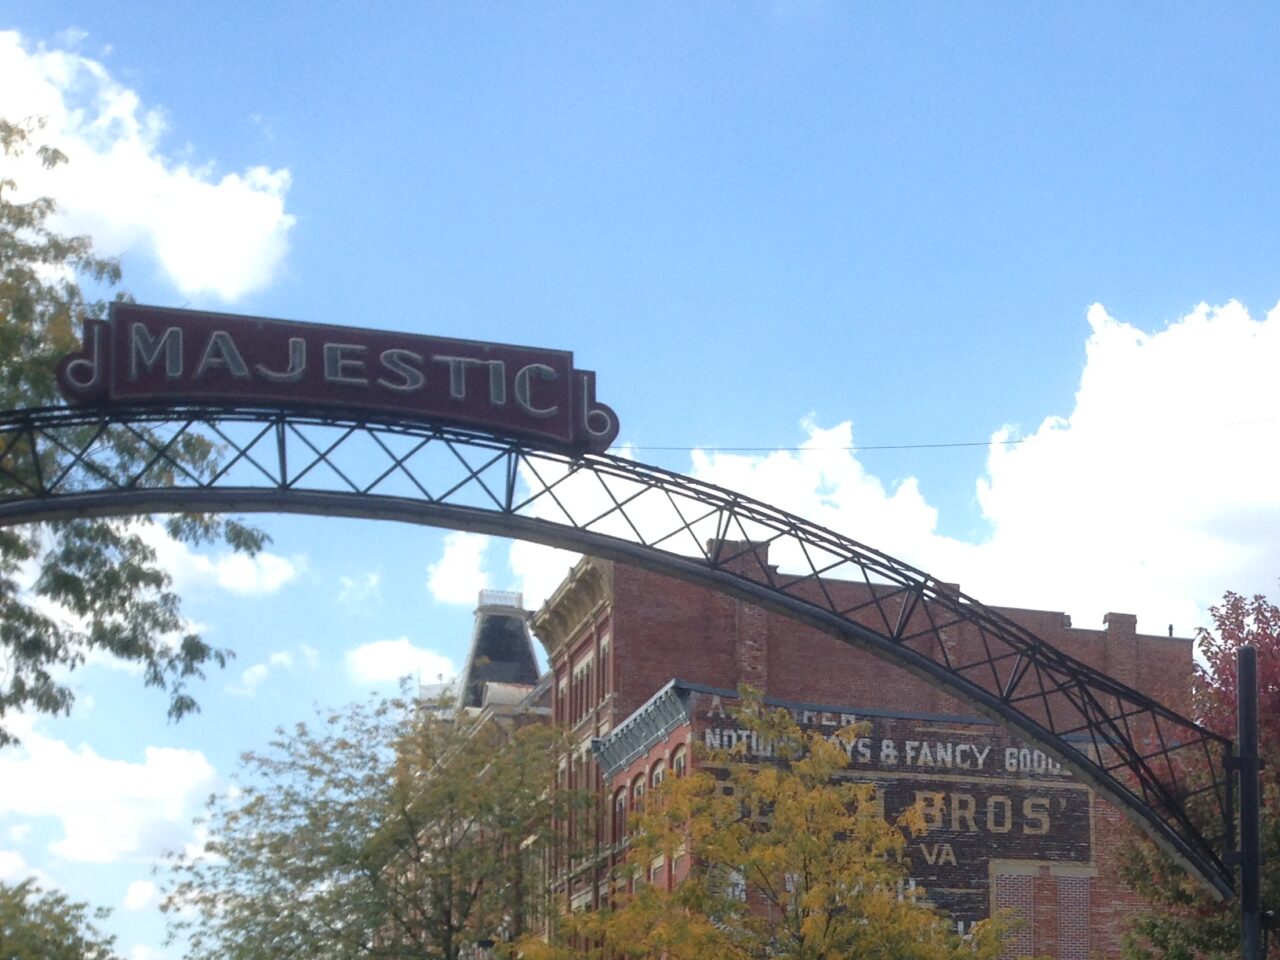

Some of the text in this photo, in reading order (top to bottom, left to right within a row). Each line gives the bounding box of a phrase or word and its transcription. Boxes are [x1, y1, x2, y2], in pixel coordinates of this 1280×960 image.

[130, 323, 559, 414] MAJESTIC
[881, 739, 898, 765] &
[905, 741, 992, 770] FANCY
